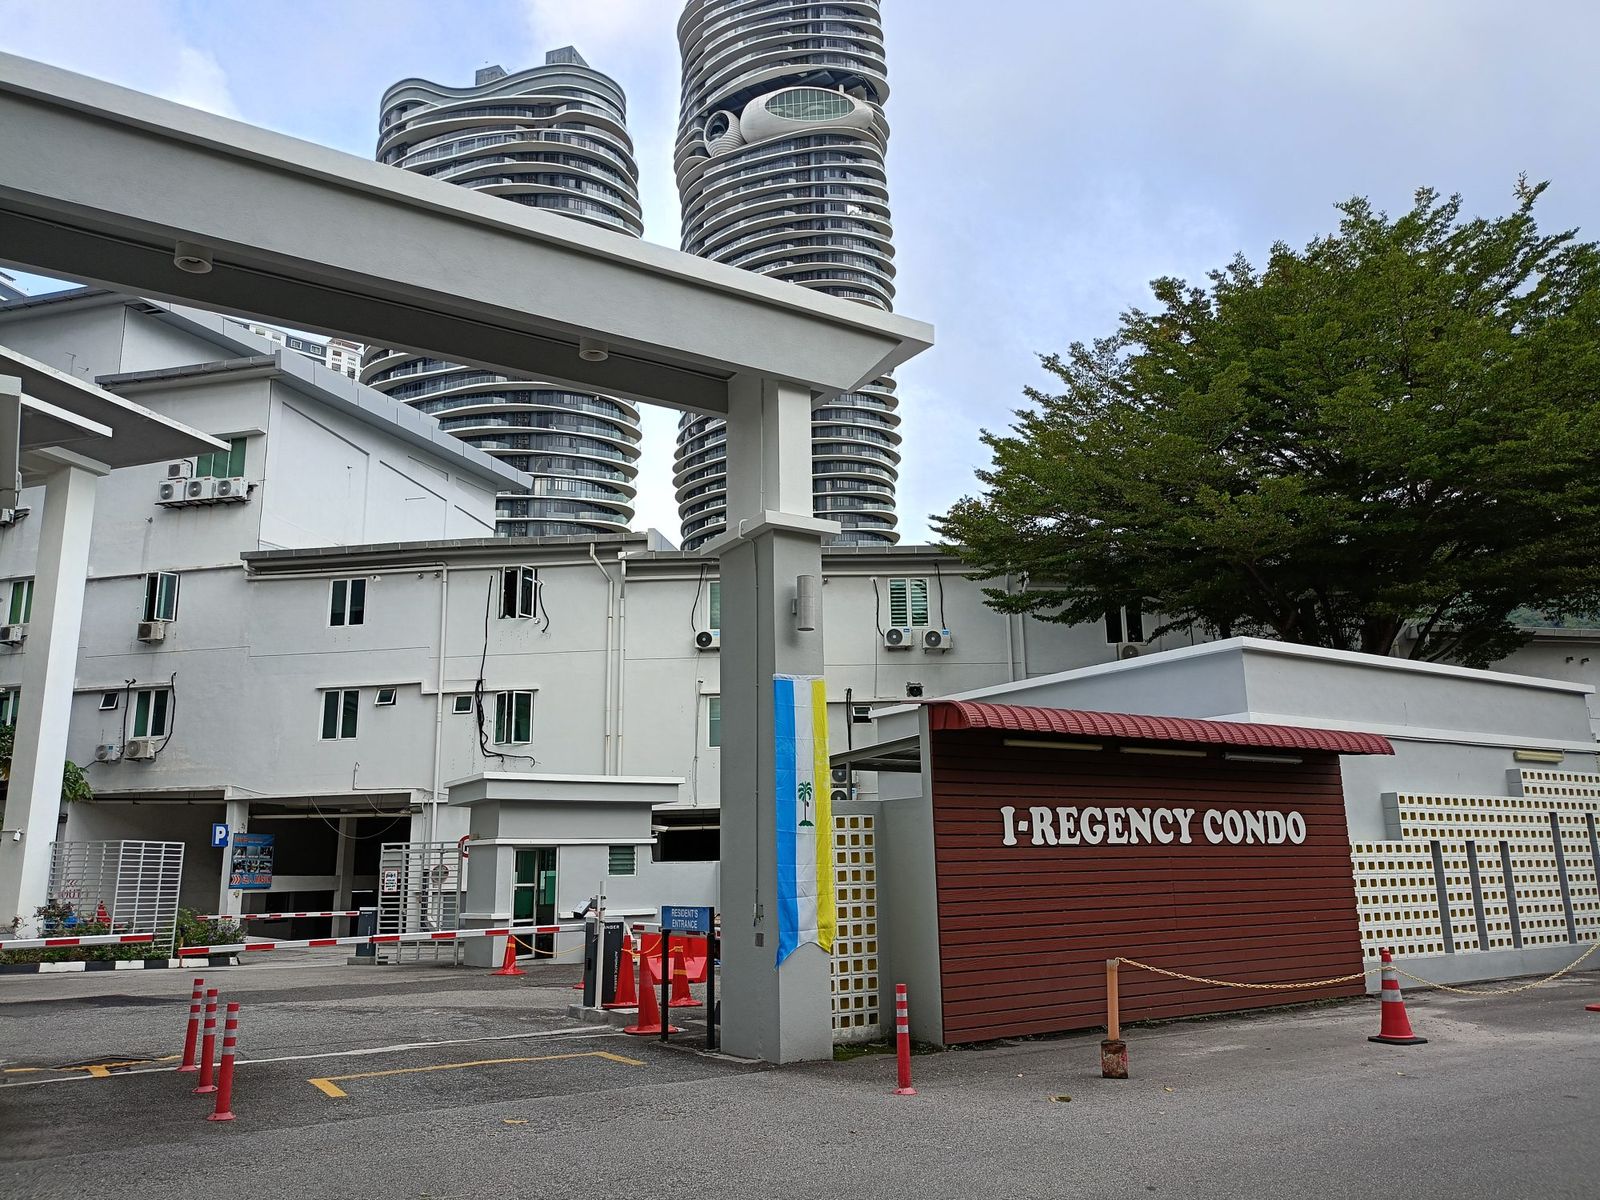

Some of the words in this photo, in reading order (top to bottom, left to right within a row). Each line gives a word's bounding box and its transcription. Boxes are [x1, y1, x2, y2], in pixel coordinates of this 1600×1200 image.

[1000, 806, 1194, 845] I-REGENCY
[1202, 809, 1306, 844] CONDO
[215, 826, 226, 844] P
[672, 919, 698, 929] ENTRANCE
